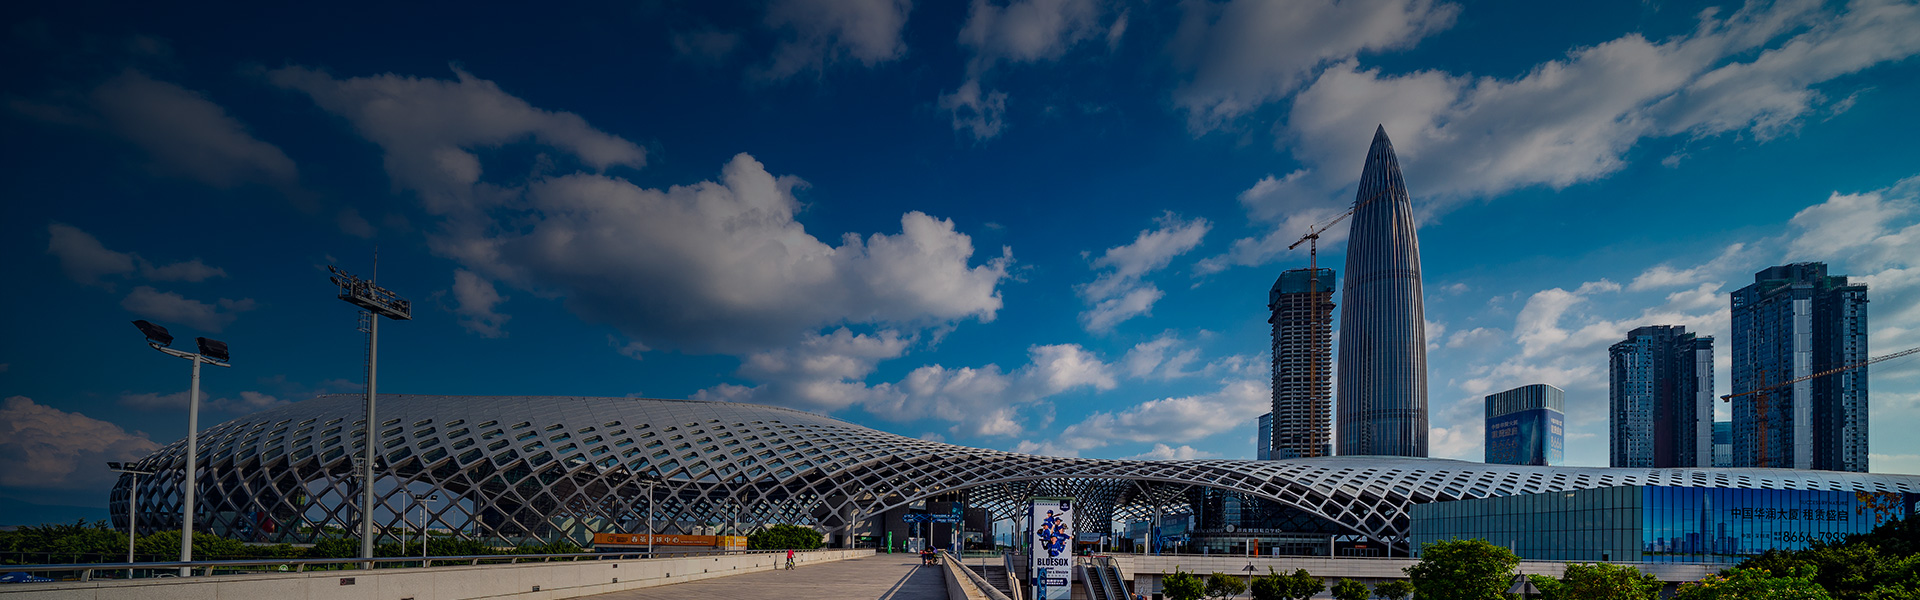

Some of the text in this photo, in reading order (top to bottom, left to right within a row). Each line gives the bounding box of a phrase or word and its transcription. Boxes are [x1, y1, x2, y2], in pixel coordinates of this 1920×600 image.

[1491, 437, 1518, 451] 8666
[1491, 450, 1518, 463] 7999
[1731, 507, 1848, 521] 中国华润大厦 租赁盛启
[1037, 558, 1069, 566] BLUESOX
